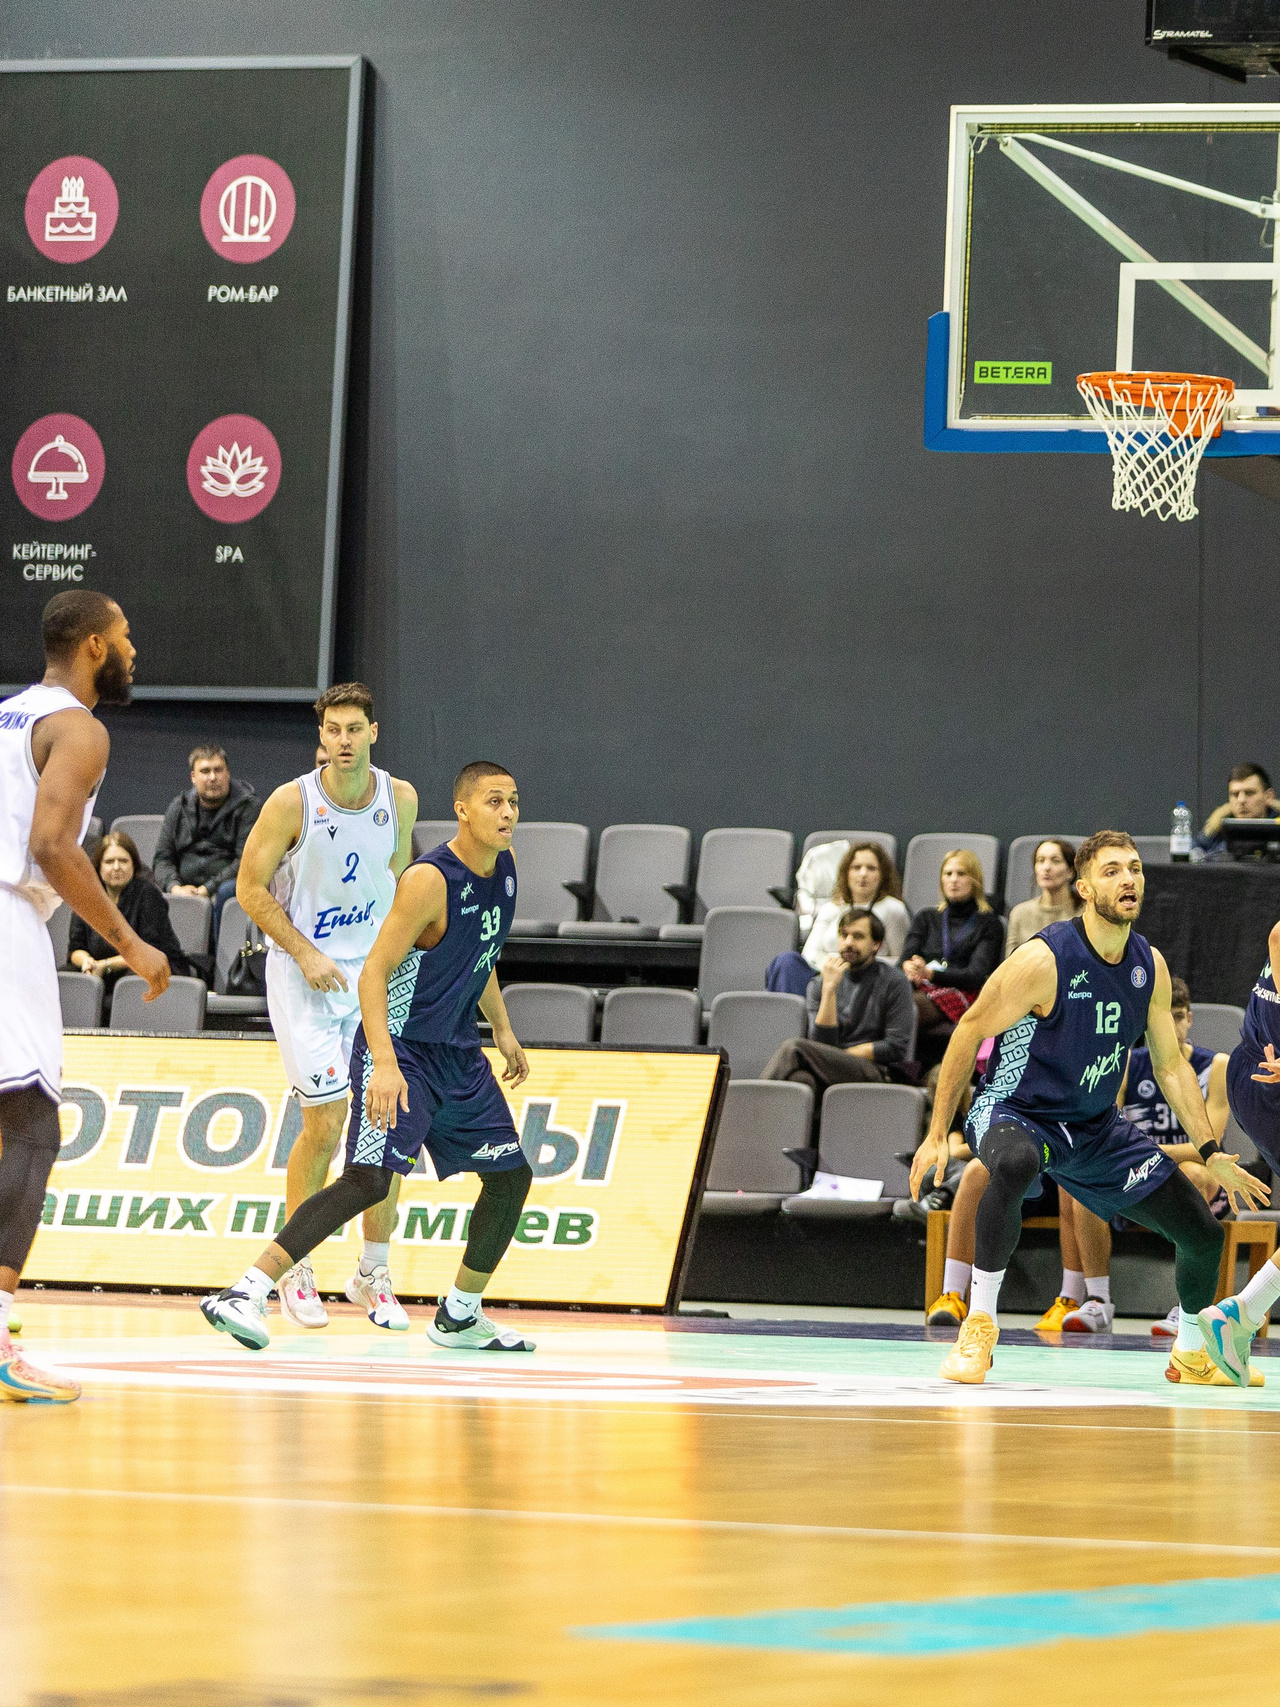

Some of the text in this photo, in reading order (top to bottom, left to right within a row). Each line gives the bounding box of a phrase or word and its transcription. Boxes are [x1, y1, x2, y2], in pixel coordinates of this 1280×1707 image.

[1152, 29, 1213, 40] STRAMATEL
[7, 283, 128, 302] БАНКЕТНЫЙ ЗАЛ
[207, 285, 279, 302] РОМ-БАР
[12, 541, 97, 561] КЕЙТЕРИНГ-
[215, 545, 244, 563] SPA
[23, 564, 84, 581] СЕРВИС
[341, 852, 360, 884] 2
[480, 905, 501, 942] 33
[1068, 991, 1092, 1000] Kempa
[1095, 1001, 1121, 1034] 12
